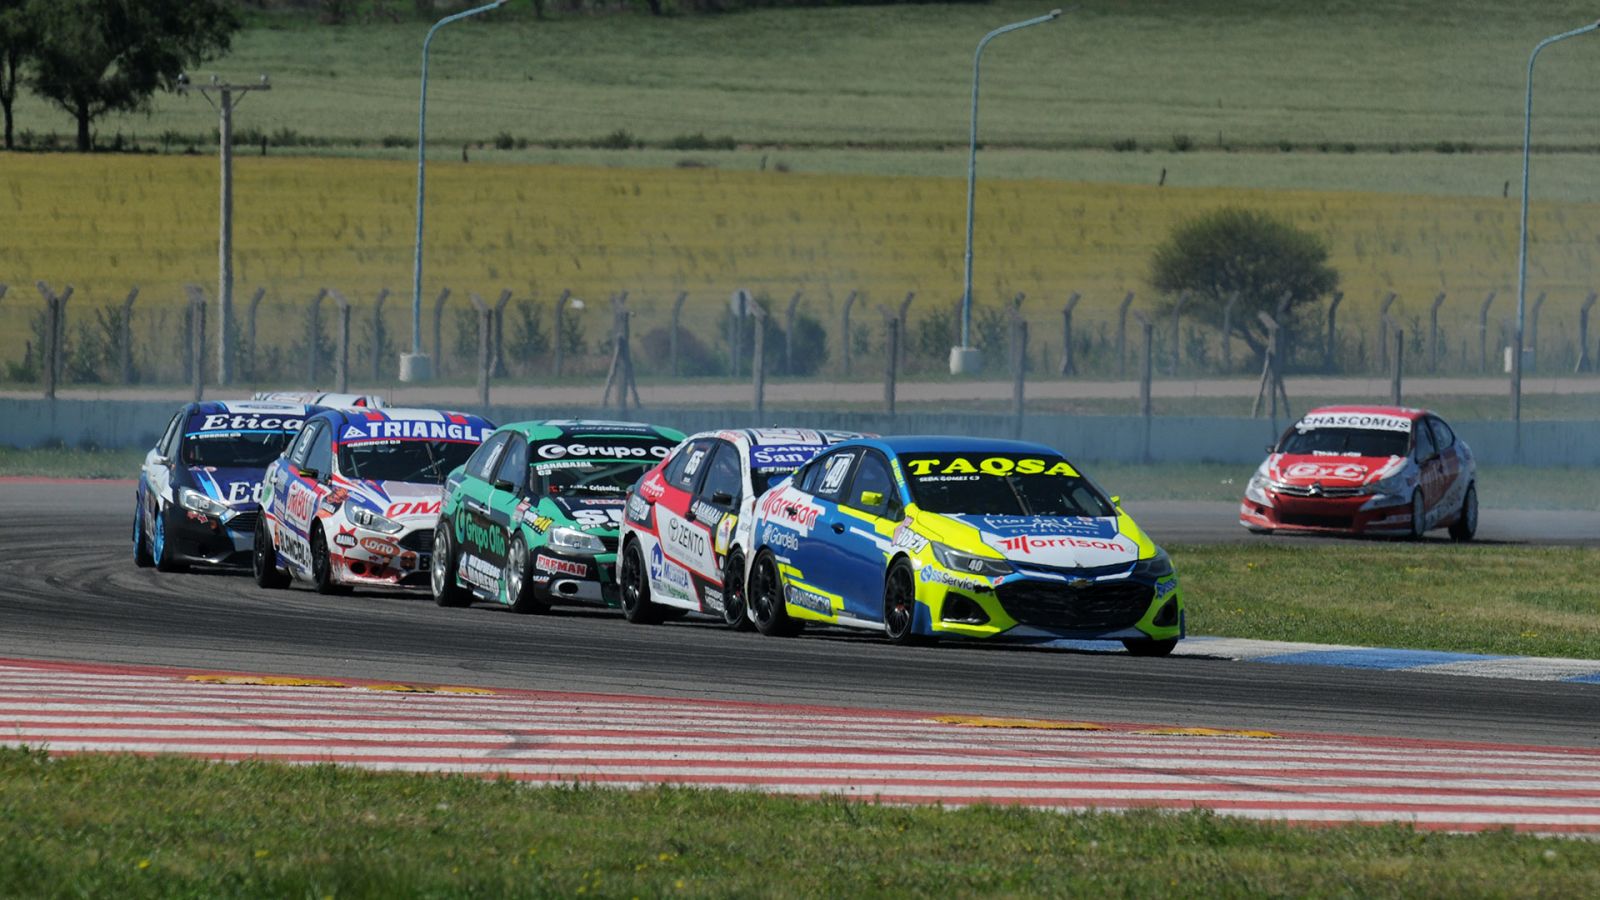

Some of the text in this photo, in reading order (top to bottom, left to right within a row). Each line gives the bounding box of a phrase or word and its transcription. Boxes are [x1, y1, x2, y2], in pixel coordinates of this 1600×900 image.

[200, 414, 304, 431] Etica
[1302, 414, 1410, 429] CHASCOMUS
[567, 443, 647, 459] Grupo
[754, 451, 806, 464] San
[908, 457, 1080, 478] TAQSA
[362, 513, 372, 525] 9
[465, 512, 489, 554] Grupo
[678, 524, 705, 558] ZENTO
[995, 534, 1125, 555] Morrison
[968, 559, 984, 572] 40
